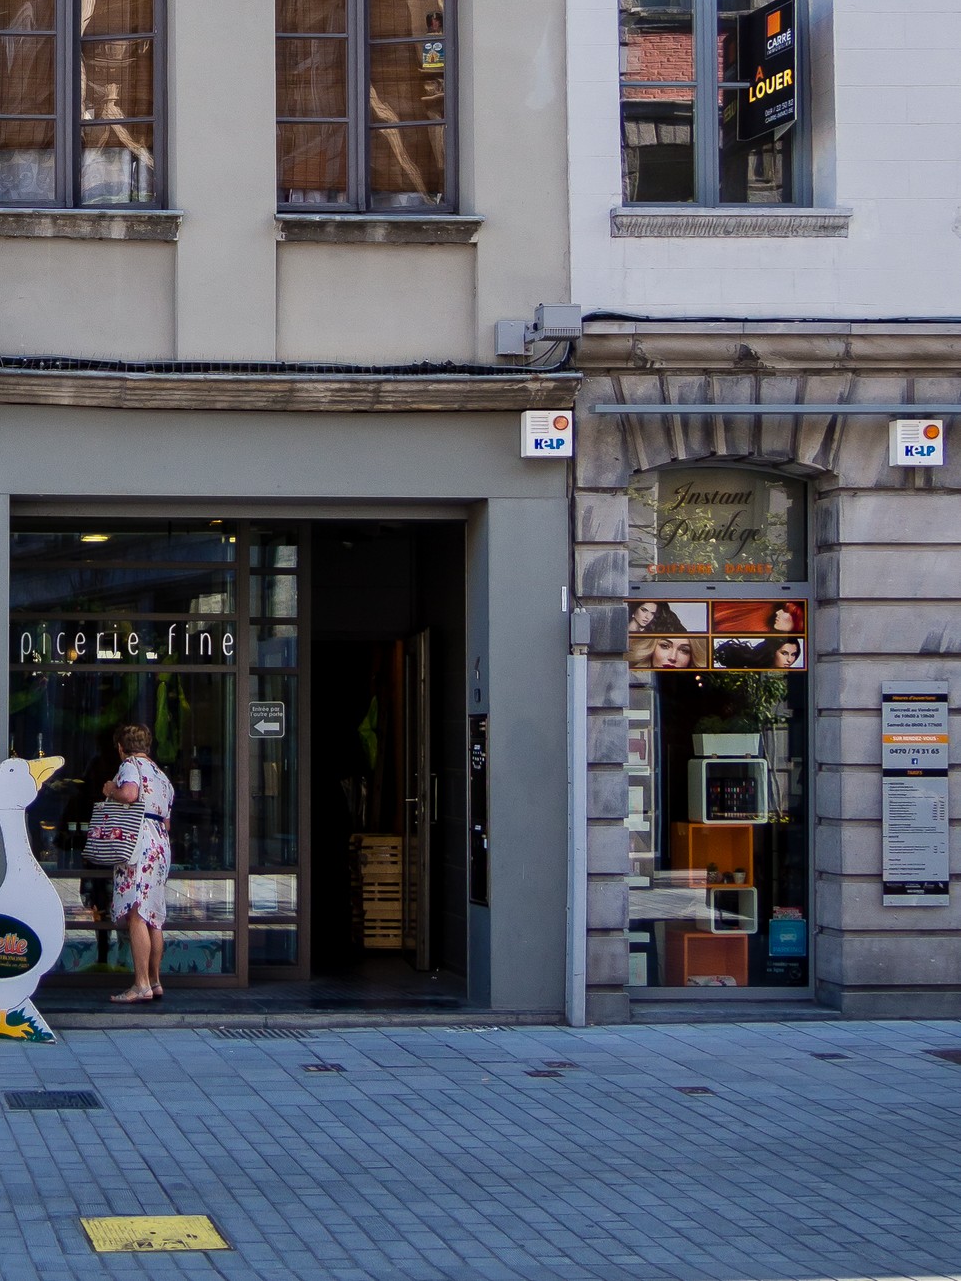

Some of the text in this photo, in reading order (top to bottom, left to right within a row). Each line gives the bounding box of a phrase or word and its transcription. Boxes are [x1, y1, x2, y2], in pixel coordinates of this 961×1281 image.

[767, 28, 791, 50] CARRÉ
[749, 68, 793, 103] LOUER
[671, 481, 753, 511] Instant
[657, 509, 763, 560] Privilège
[647, 563, 773, 575] COIFFURE DAMES
[20, 623, 234, 663] picerie fine
